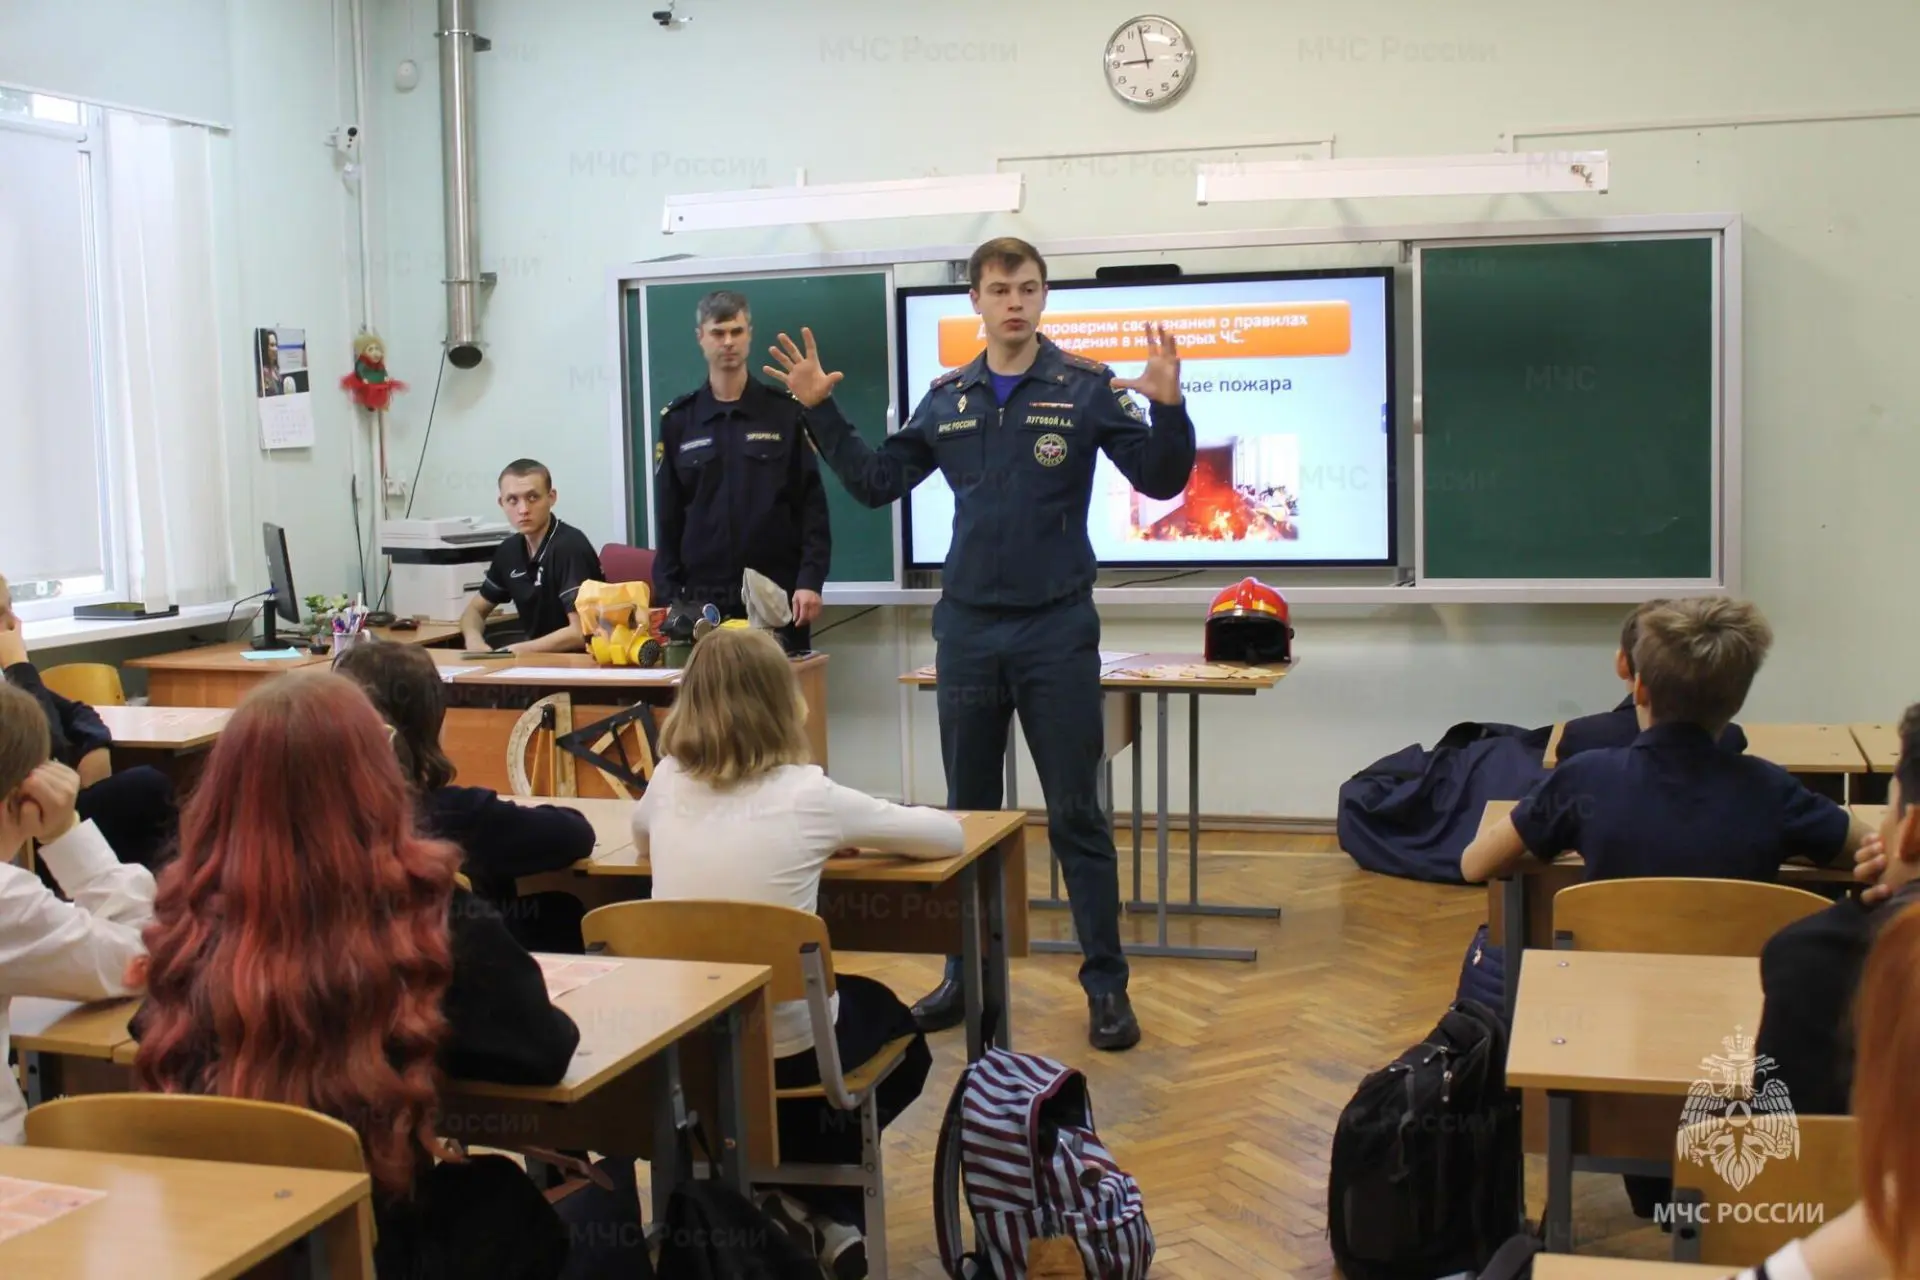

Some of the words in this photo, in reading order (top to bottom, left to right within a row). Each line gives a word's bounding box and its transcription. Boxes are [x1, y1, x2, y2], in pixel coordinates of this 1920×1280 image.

[1169, 38, 1177, 46] 2
[1116, 45, 1125, 53] 10
[1176, 53, 1184, 62] 3
[1112, 60, 1120, 69] 9
[1171, 69, 1180, 78] 4
[1118, 76, 1127, 84] 8
[1130, 86, 1137, 95] 7
[1160, 82, 1169, 92] 5
[1145, 89, 1154, 98] 6
[1043, 322, 1118, 337] проверим
[1161, 317, 1215, 330] знания
[1220, 317, 1230, 328] о
[1235, 314, 1308, 329] правилах
[1055, 336, 1118, 351] ведения
[1123, 336, 1130, 347] в
[1220, 379, 1292, 394] пожара
